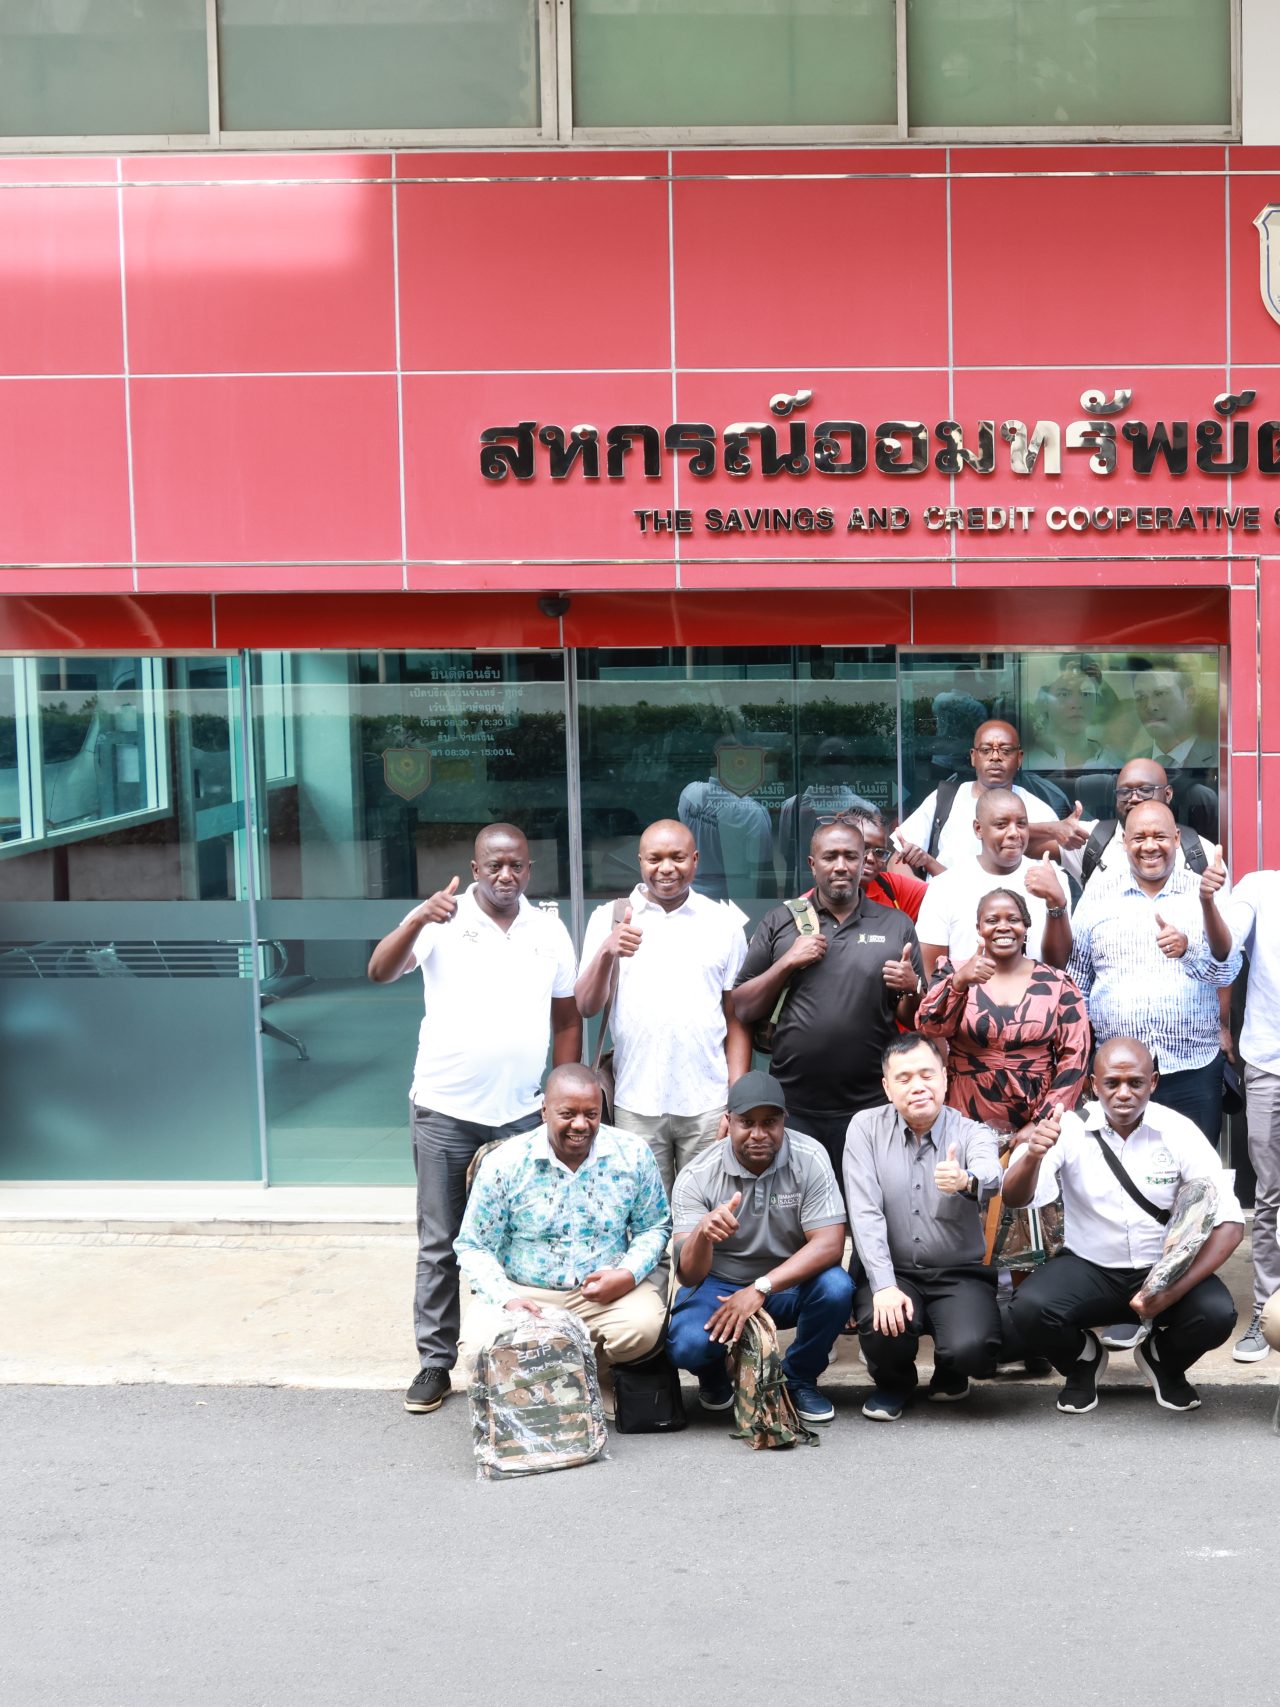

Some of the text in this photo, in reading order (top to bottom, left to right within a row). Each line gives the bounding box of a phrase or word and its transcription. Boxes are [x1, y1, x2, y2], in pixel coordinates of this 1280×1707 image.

[633, 508, 693, 533] THE
[704, 506, 835, 532] SAVINGS
[846, 506, 911, 532] AND
[922, 506, 1036, 531] CREDIT
[1045, 506, 1261, 531] COOPERATIVE
